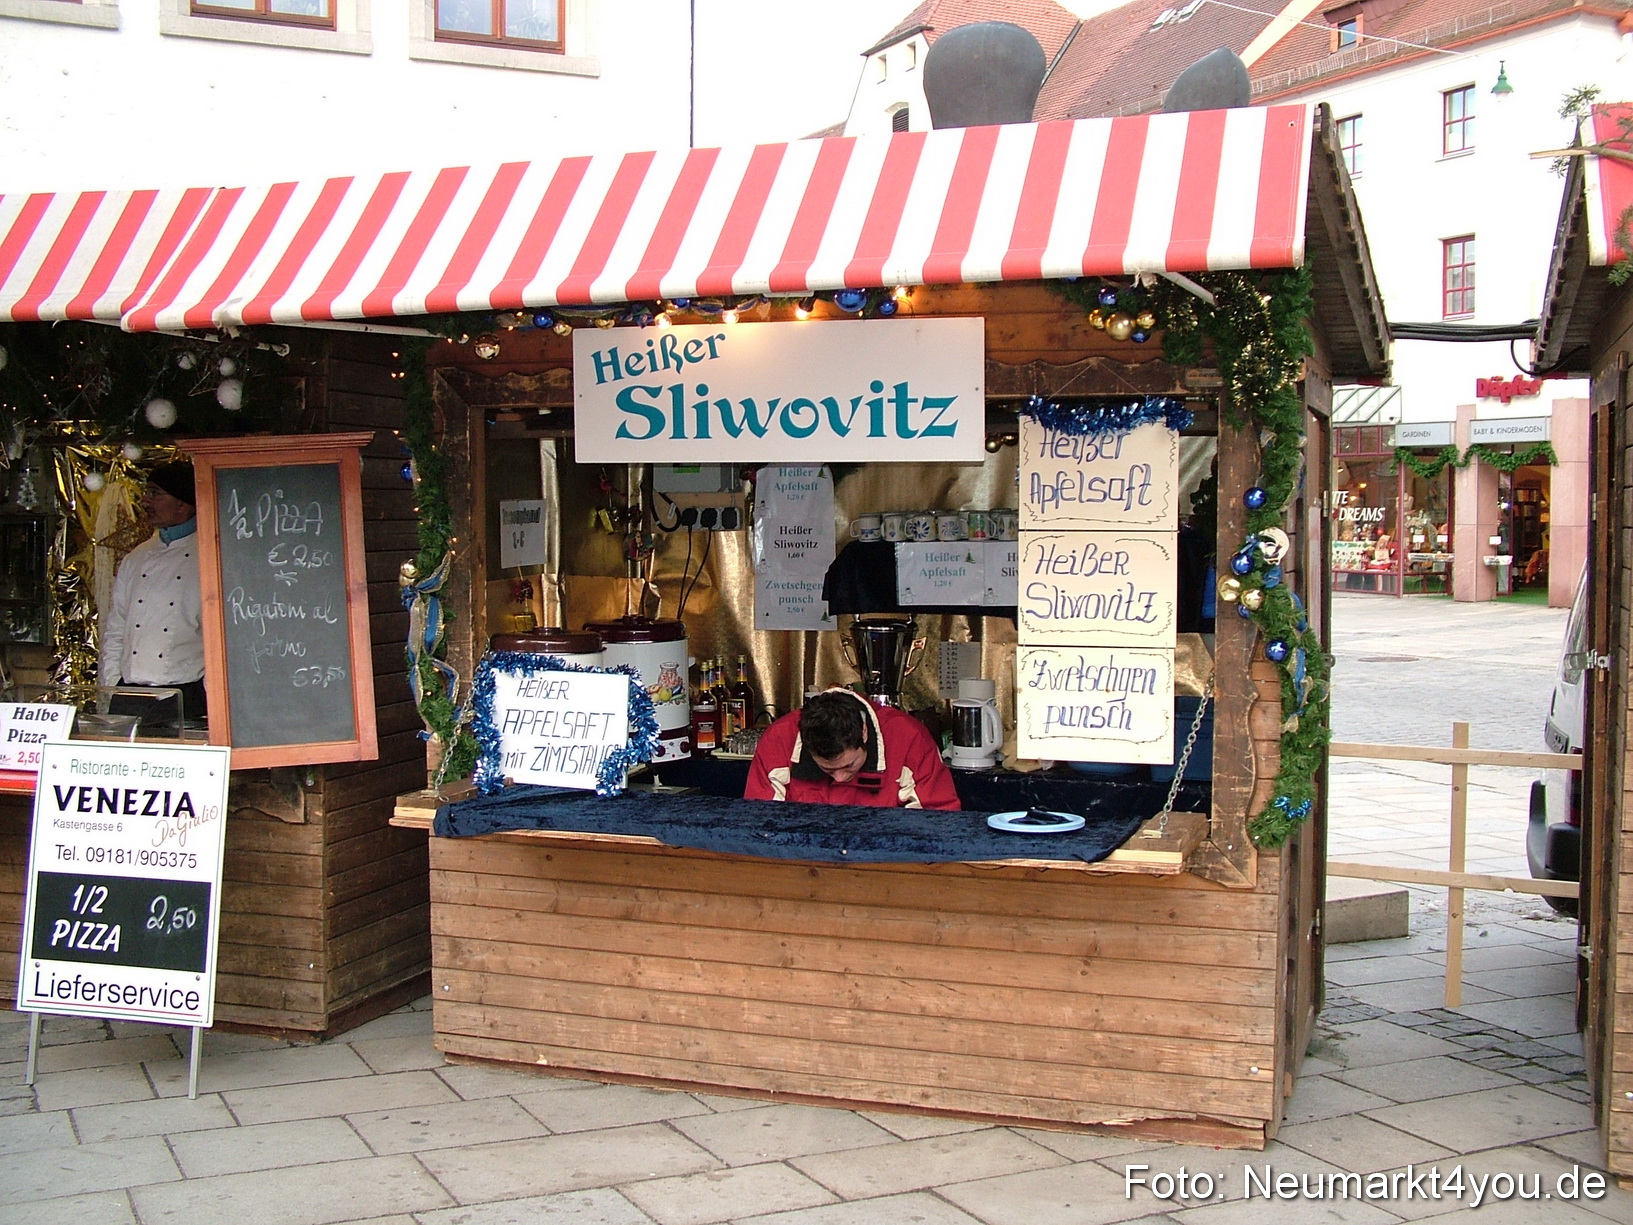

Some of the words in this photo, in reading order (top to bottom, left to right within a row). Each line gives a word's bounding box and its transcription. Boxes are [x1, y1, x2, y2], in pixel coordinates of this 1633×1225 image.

[591, 333, 726, 385] Heißer
[615, 380, 960, 440] Sliwovitz
[1402, 430, 1431, 438] GARDINEN
[1496, 425, 1543, 434] KINDERMODEN
[779, 467, 813, 477] Heißer
[773, 481, 818, 493] Apfelsaft
[1030, 463, 1152, 514] Apfelsaft
[1339, 507, 1385, 521] DREAMS
[779, 525, 813, 535] Heißer
[774, 540, 818, 549] Sliwovitz
[924, 552, 960, 562] Heißer
[920, 567, 966, 579] Apfelsaft
[778, 594, 814, 605] punsch
[12, 707, 59, 721] Halbe
[1043, 702, 1132, 733] punsch
[502, 708, 616, 740] APFELSAFT
[70, 758, 129, 776] Ristorante
[140, 762, 185, 779] Pizzeria
[53, 785, 196, 819] VENEZIA
[53, 818, 114, 832] Kastengasse
[116, 823, 123, 832] 6
[55, 844, 80, 861] Tel.
[85, 846, 197, 869] 09181/905375
[72, 884, 109, 915] 1/2
[146, 895, 197, 935] 2,50
[51, 919, 121, 952] PIZZA
[34, 971, 200, 1010] Lieferservice
